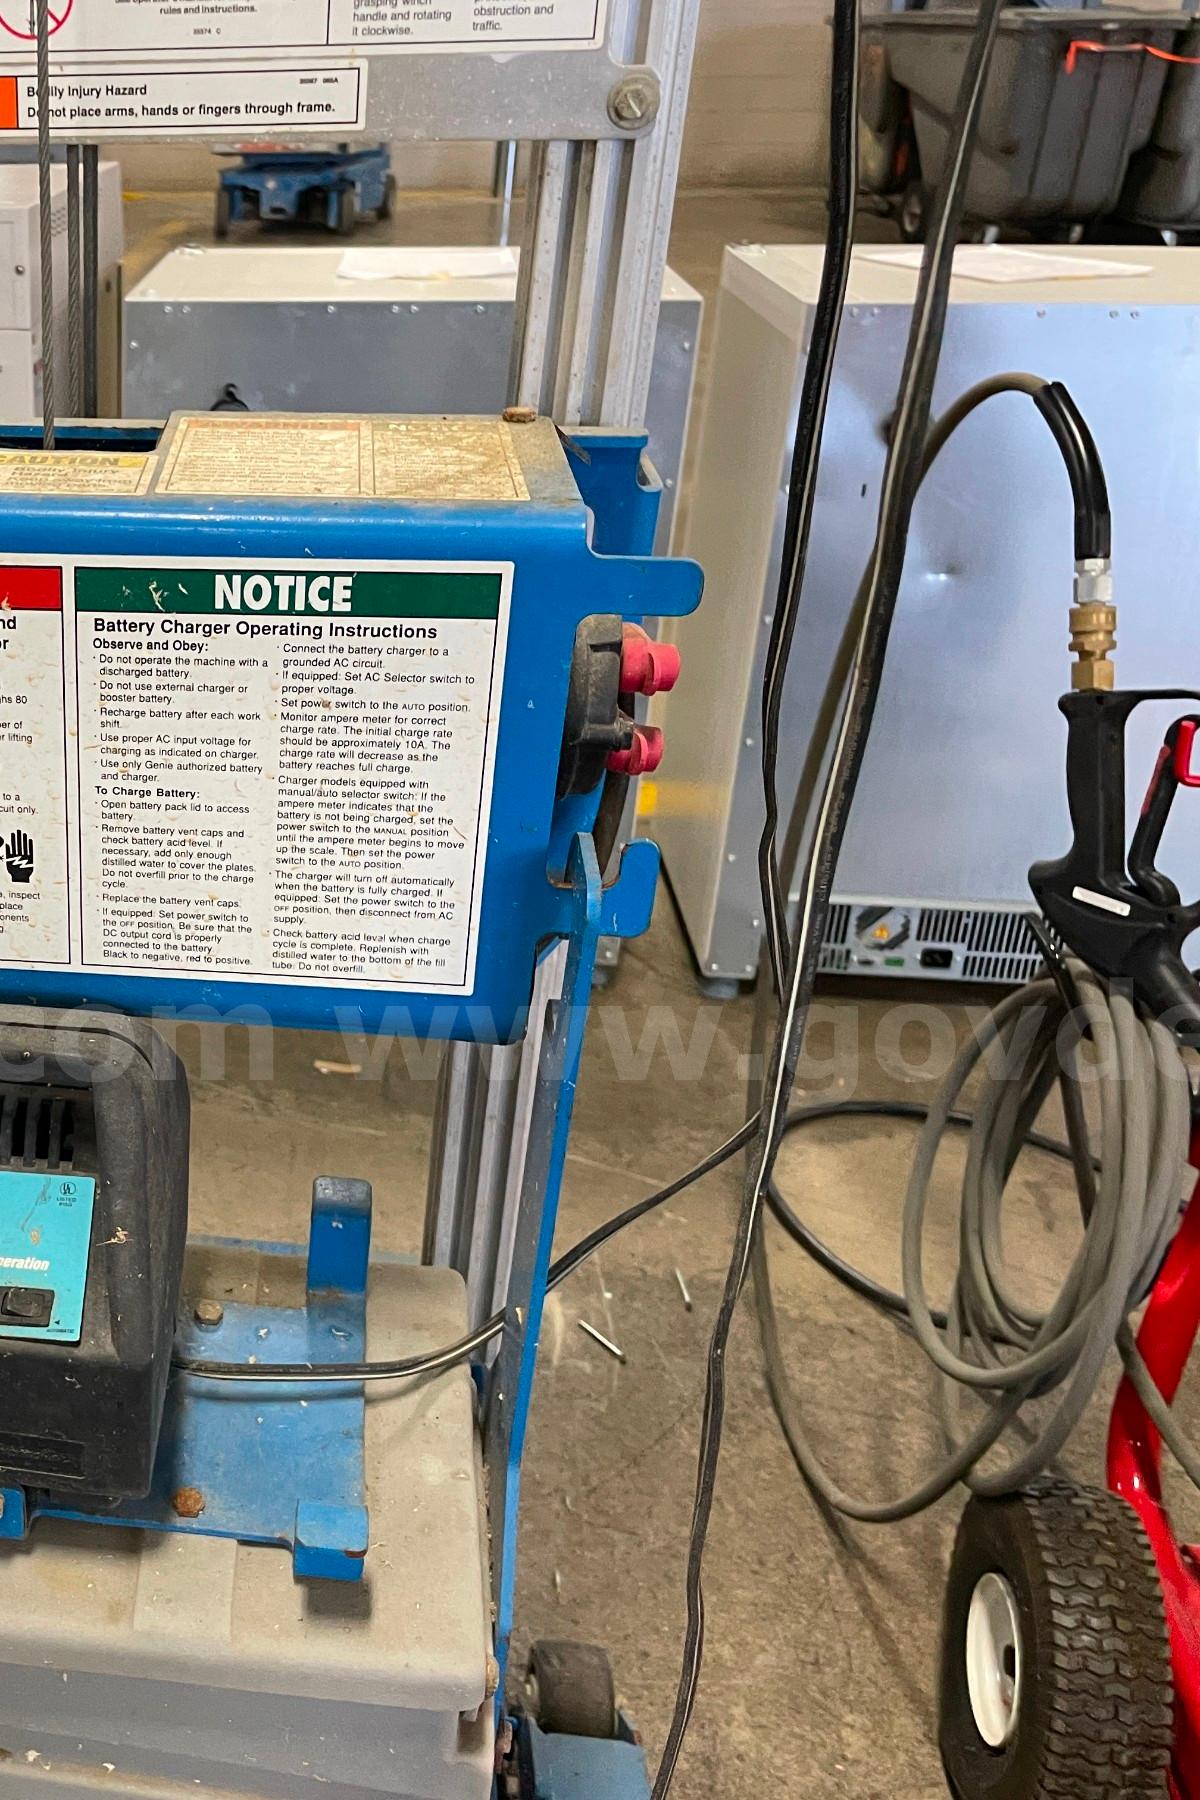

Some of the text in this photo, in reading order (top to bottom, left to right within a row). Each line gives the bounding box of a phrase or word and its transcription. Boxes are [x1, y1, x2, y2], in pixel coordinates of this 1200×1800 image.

[159, 5, 256, 15] rules and instructions.
[352, 10, 452, 22] handle and rotating
[473, 3, 554, 16] obstruction and
[352, 25, 413, 36] it clockwise.
[472, 20, 502, 31] traffic.
[27, 84, 147, 99] Bily Injury Hazard
[49, 106, 66, 118] not
[69, 105, 101, 120] place
[104, 107, 138, 117] arms,
[141, 104, 179, 116] hands
[182, 106, 195, 115] or
[198, 103, 241, 118] fingers
[244, 102, 293, 116] through
[297, 101, 335, 113] frame.
[71, 467, 120, 475] Injury
[214, 574, 353, 612] NOTICE
[94, 617, 437, 640] Battery Charger Operating Instructions
[92, 637, 208, 654] Observe and Obey:
[283, 643, 449, 658] Connect the battery charger to a
[99, 653, 268, 668] Do not operate the machine with a
[282, 657, 383, 669] grounded AC circuit.
[99, 666, 189, 679] discharged battery.
[15, 695, 28, 704] 80
[2, 792, 12, 801] to
[94, 785, 200, 800] To Charge Battery:
[16, 805, 36, 816] only.
[103, 949, 250, 965] Black to negative, red to positive.
